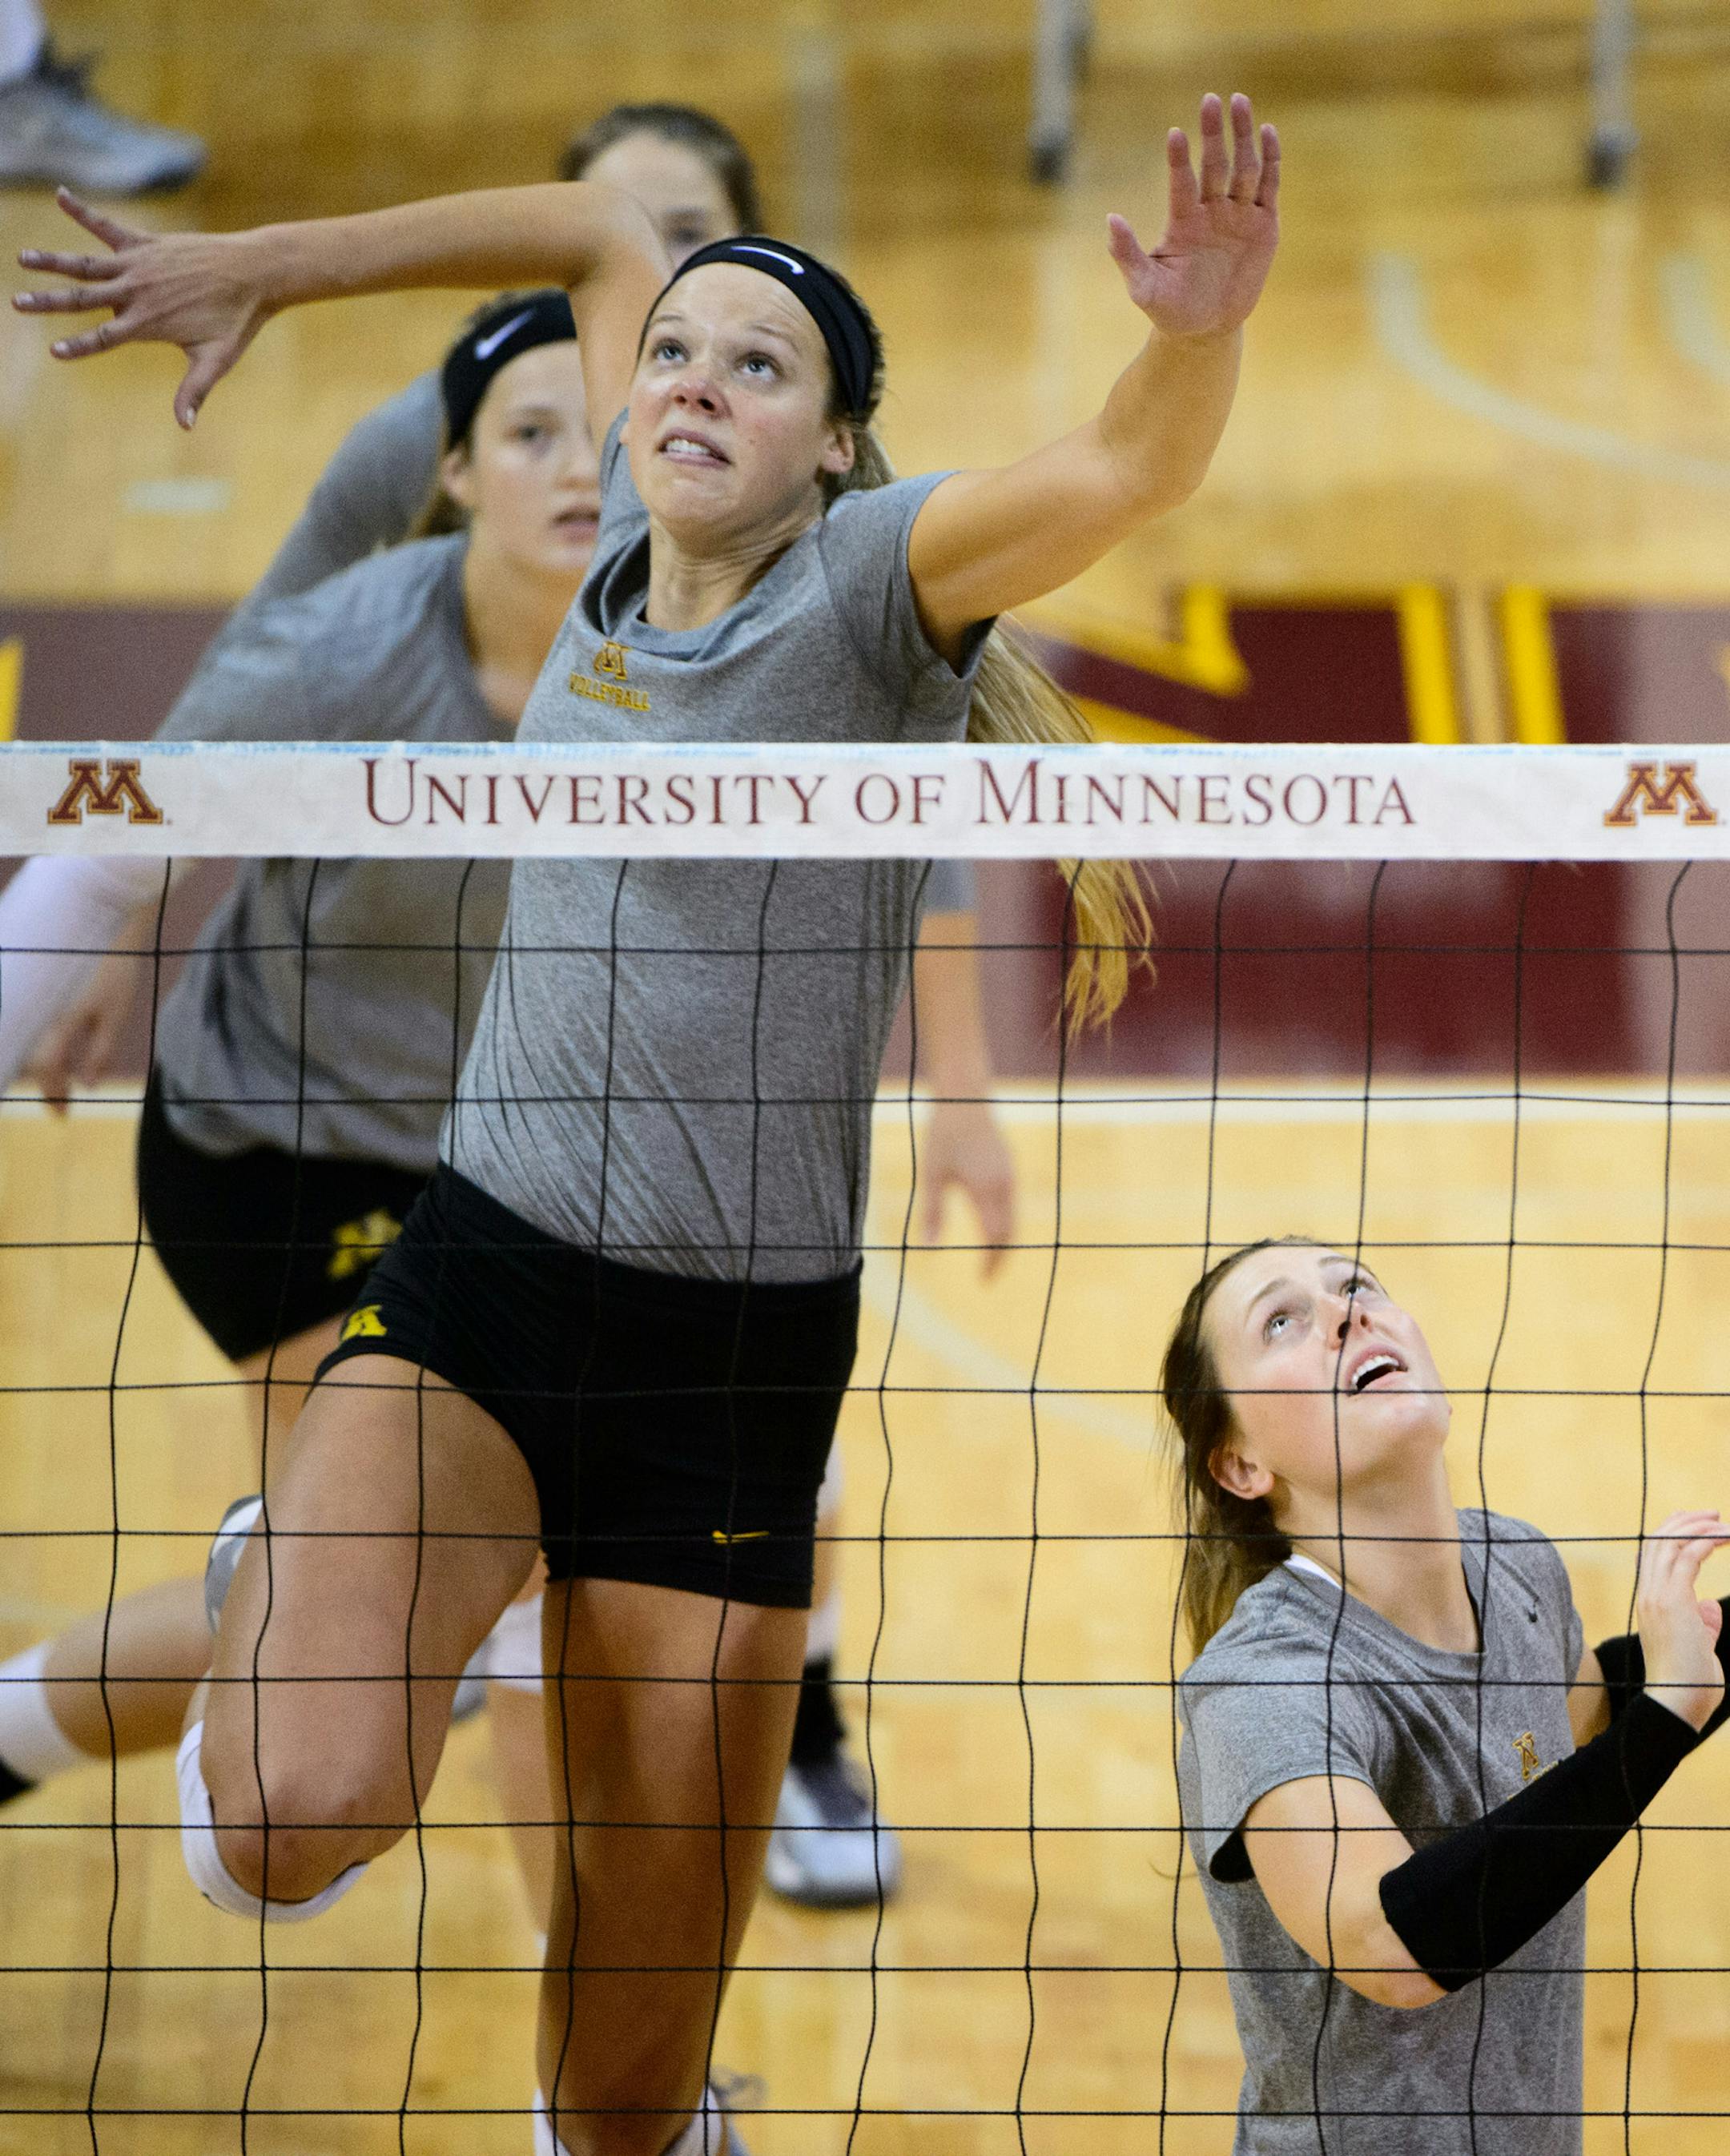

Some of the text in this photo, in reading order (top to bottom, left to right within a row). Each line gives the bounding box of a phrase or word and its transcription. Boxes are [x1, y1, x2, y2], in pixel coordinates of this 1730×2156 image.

[569, 672, 651, 712] VOLLEYBALL
[46, 758, 164, 826] M
[362, 758, 1417, 826] UNIVERSITY OF MINNESOTA
[1603, 761, 1719, 827] M
